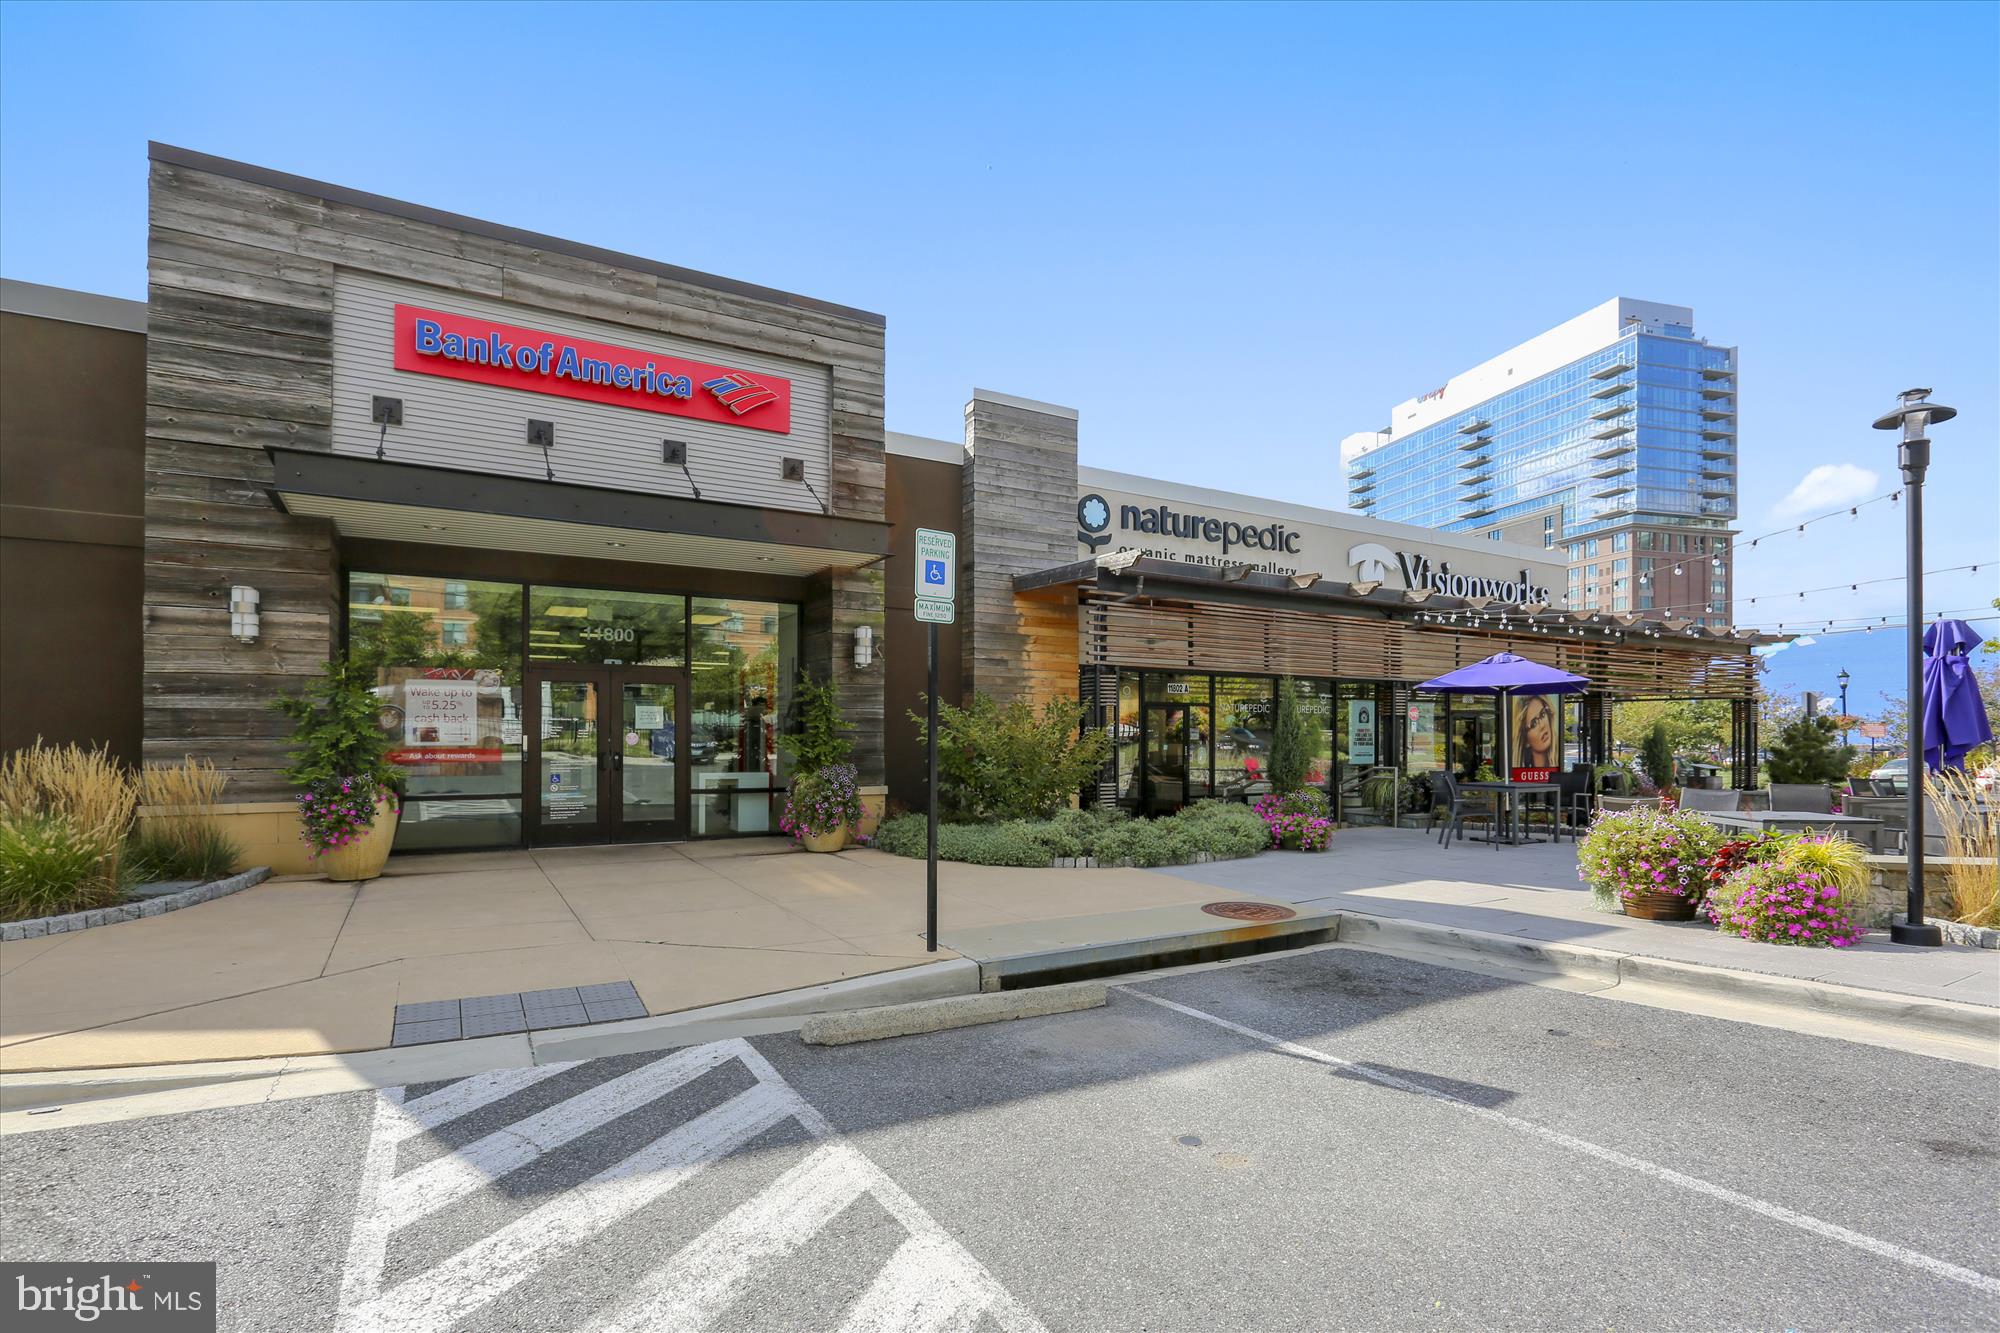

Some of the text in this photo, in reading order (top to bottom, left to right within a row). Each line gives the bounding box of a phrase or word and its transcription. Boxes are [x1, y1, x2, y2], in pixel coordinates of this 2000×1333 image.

[415, 318, 693, 399] Bank of America
[1121, 505, 1301, 554] naturepedic
[919, 536, 952, 549] RESERVED
[921, 549, 949, 560] PARKING
[1397, 552, 1550, 605] Visionworks
[919, 603, 951, 612] MAXIMUM
[583, 626, 635, 642] 11800
[410, 687, 473, 699] Wake up to
[1168, 684, 1189, 693] 11802 A
[1220, 703, 1271, 713] NATUREPEDIC
[1297, 705, 1329, 714] UREPEDIC
[414, 713, 470, 723] cash back
[1521, 771, 1550, 781] GUESS
